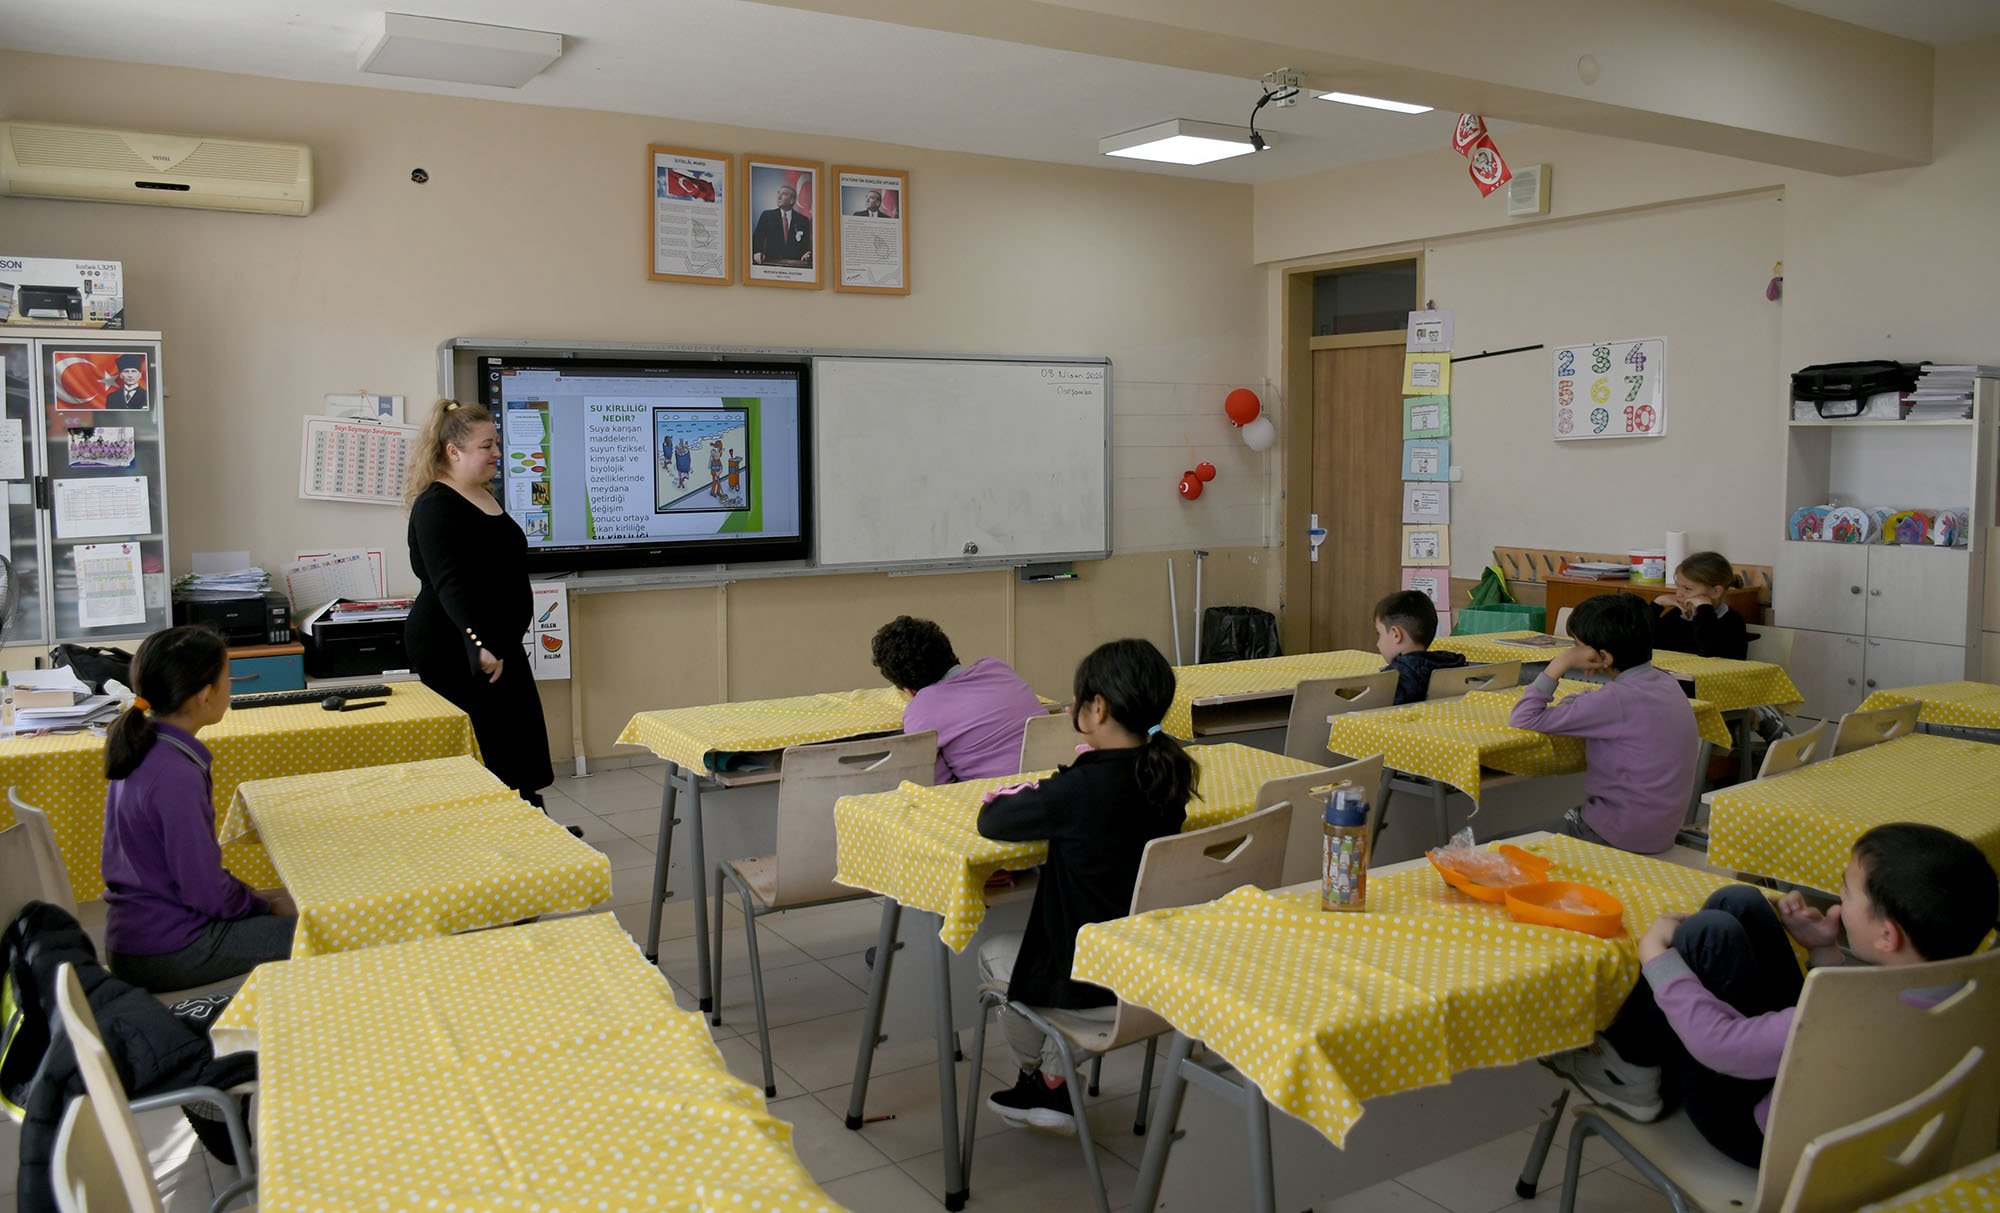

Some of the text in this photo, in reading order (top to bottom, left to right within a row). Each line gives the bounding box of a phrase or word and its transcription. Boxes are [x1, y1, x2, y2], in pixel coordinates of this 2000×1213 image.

[1558, 343, 1646, 377] 2 3 4
[1559, 375, 1644, 406] 5 6 7
[590, 403, 647, 412] SU KİRLİLİĞİ
[602, 413, 636, 422] NEDİR?
[1558, 404, 1656, 434] 8 9 10
[589, 425, 642, 433] Suya karışan
[590, 435, 639, 443] maddelerin,
[590, 445, 647, 454] suyun fiziksel,
[590, 455, 627, 464] kimyasal
[590, 465, 624, 474] biyolojik
[590, 475, 645, 483] özelliklerinde
[591, 485, 629, 493] meydana
[591, 495, 625, 504] getirdiği
[591, 505, 624, 514] değişim
[592, 515, 649, 523] sonucu ortaya
[592, 524, 645, 534] çıkan kirliliğe
